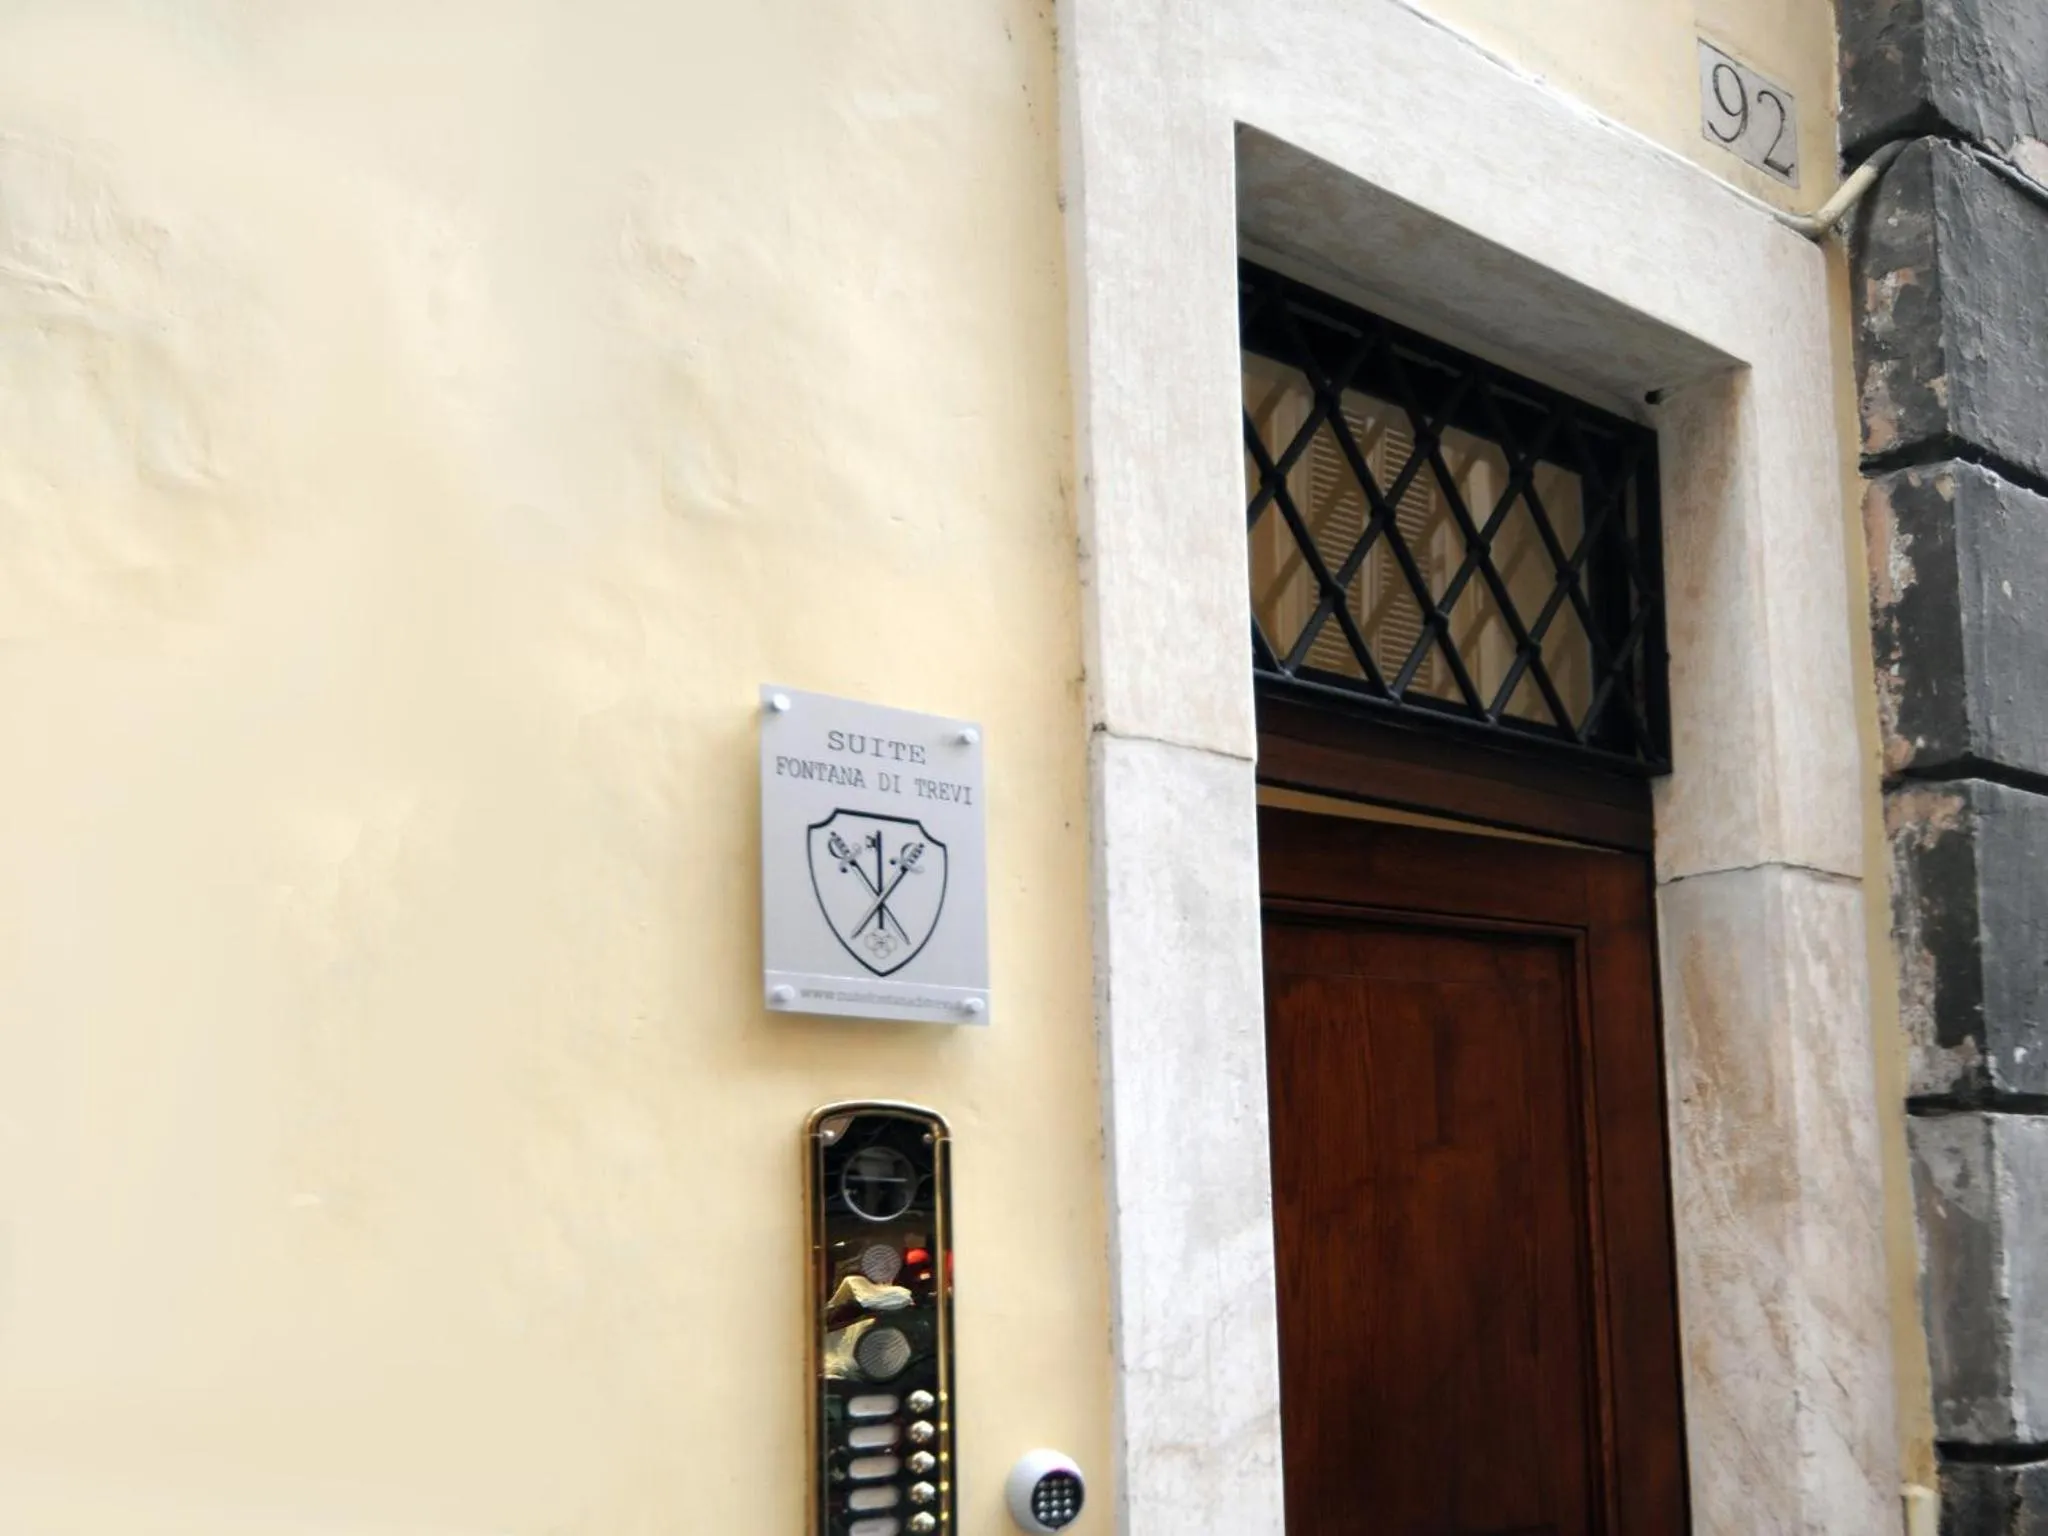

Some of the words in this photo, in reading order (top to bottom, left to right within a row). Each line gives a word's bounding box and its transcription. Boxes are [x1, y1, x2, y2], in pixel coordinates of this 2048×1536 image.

[1707, 63, 1795, 178] 92
[827, 730, 926, 765] SUITE
[775, 756, 866, 789] FONTANA
[878, 772, 901, 793] DI
[914, 778, 973, 806] TREVI
